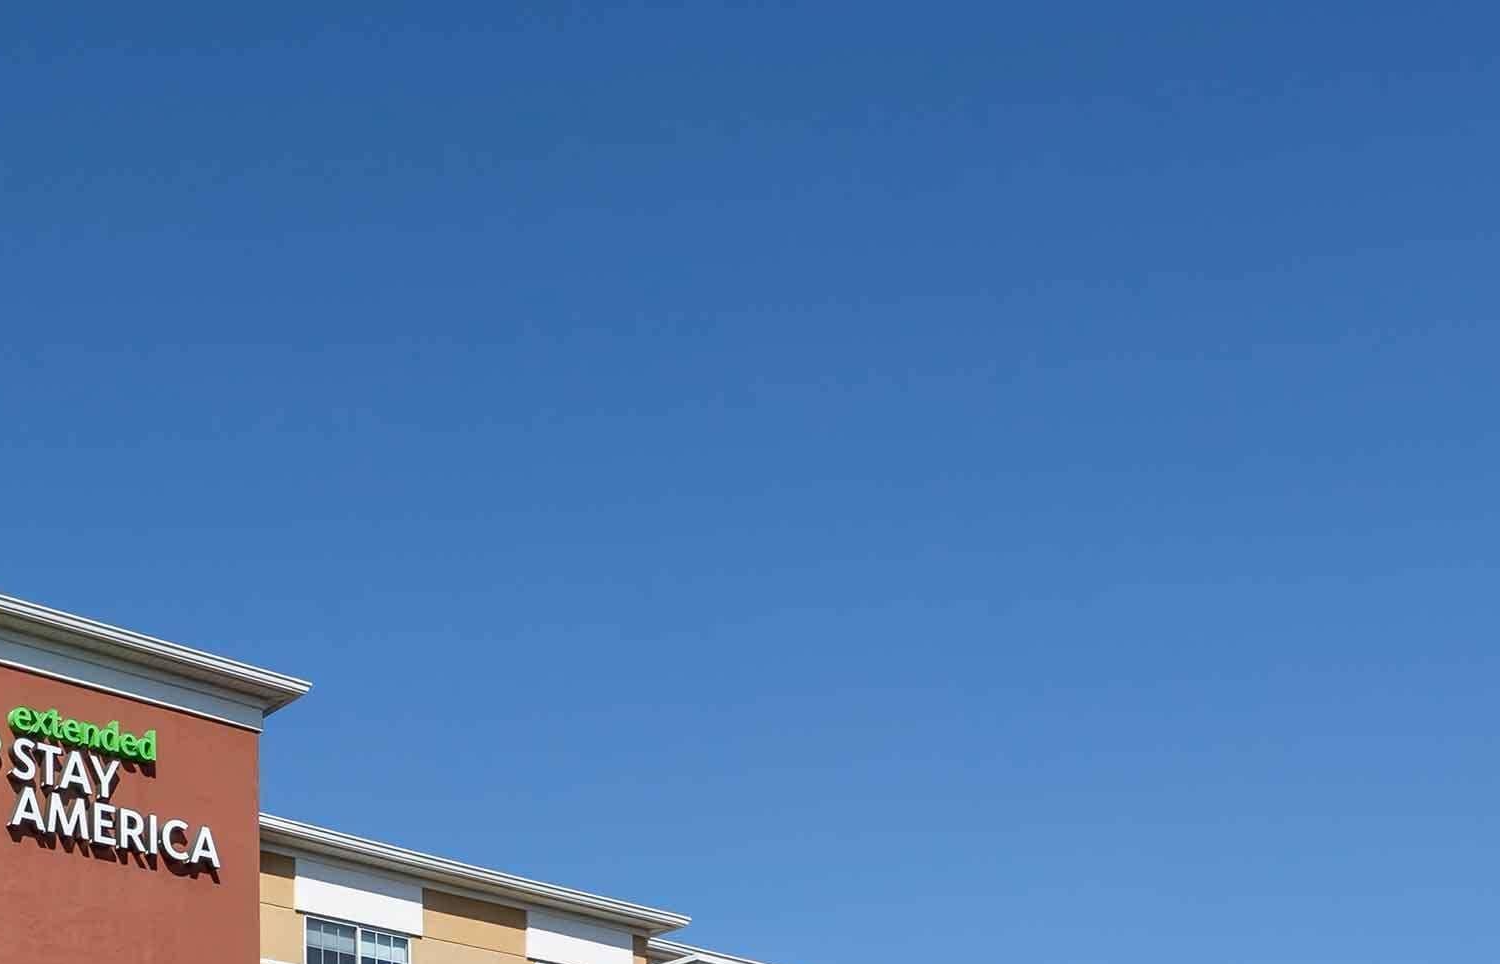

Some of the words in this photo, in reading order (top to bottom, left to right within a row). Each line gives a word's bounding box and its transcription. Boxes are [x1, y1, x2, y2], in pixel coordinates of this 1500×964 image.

[8, 705, 157, 761] extended
[11, 737, 120, 798] STAY
[9, 786, 220, 868] AMERICA
